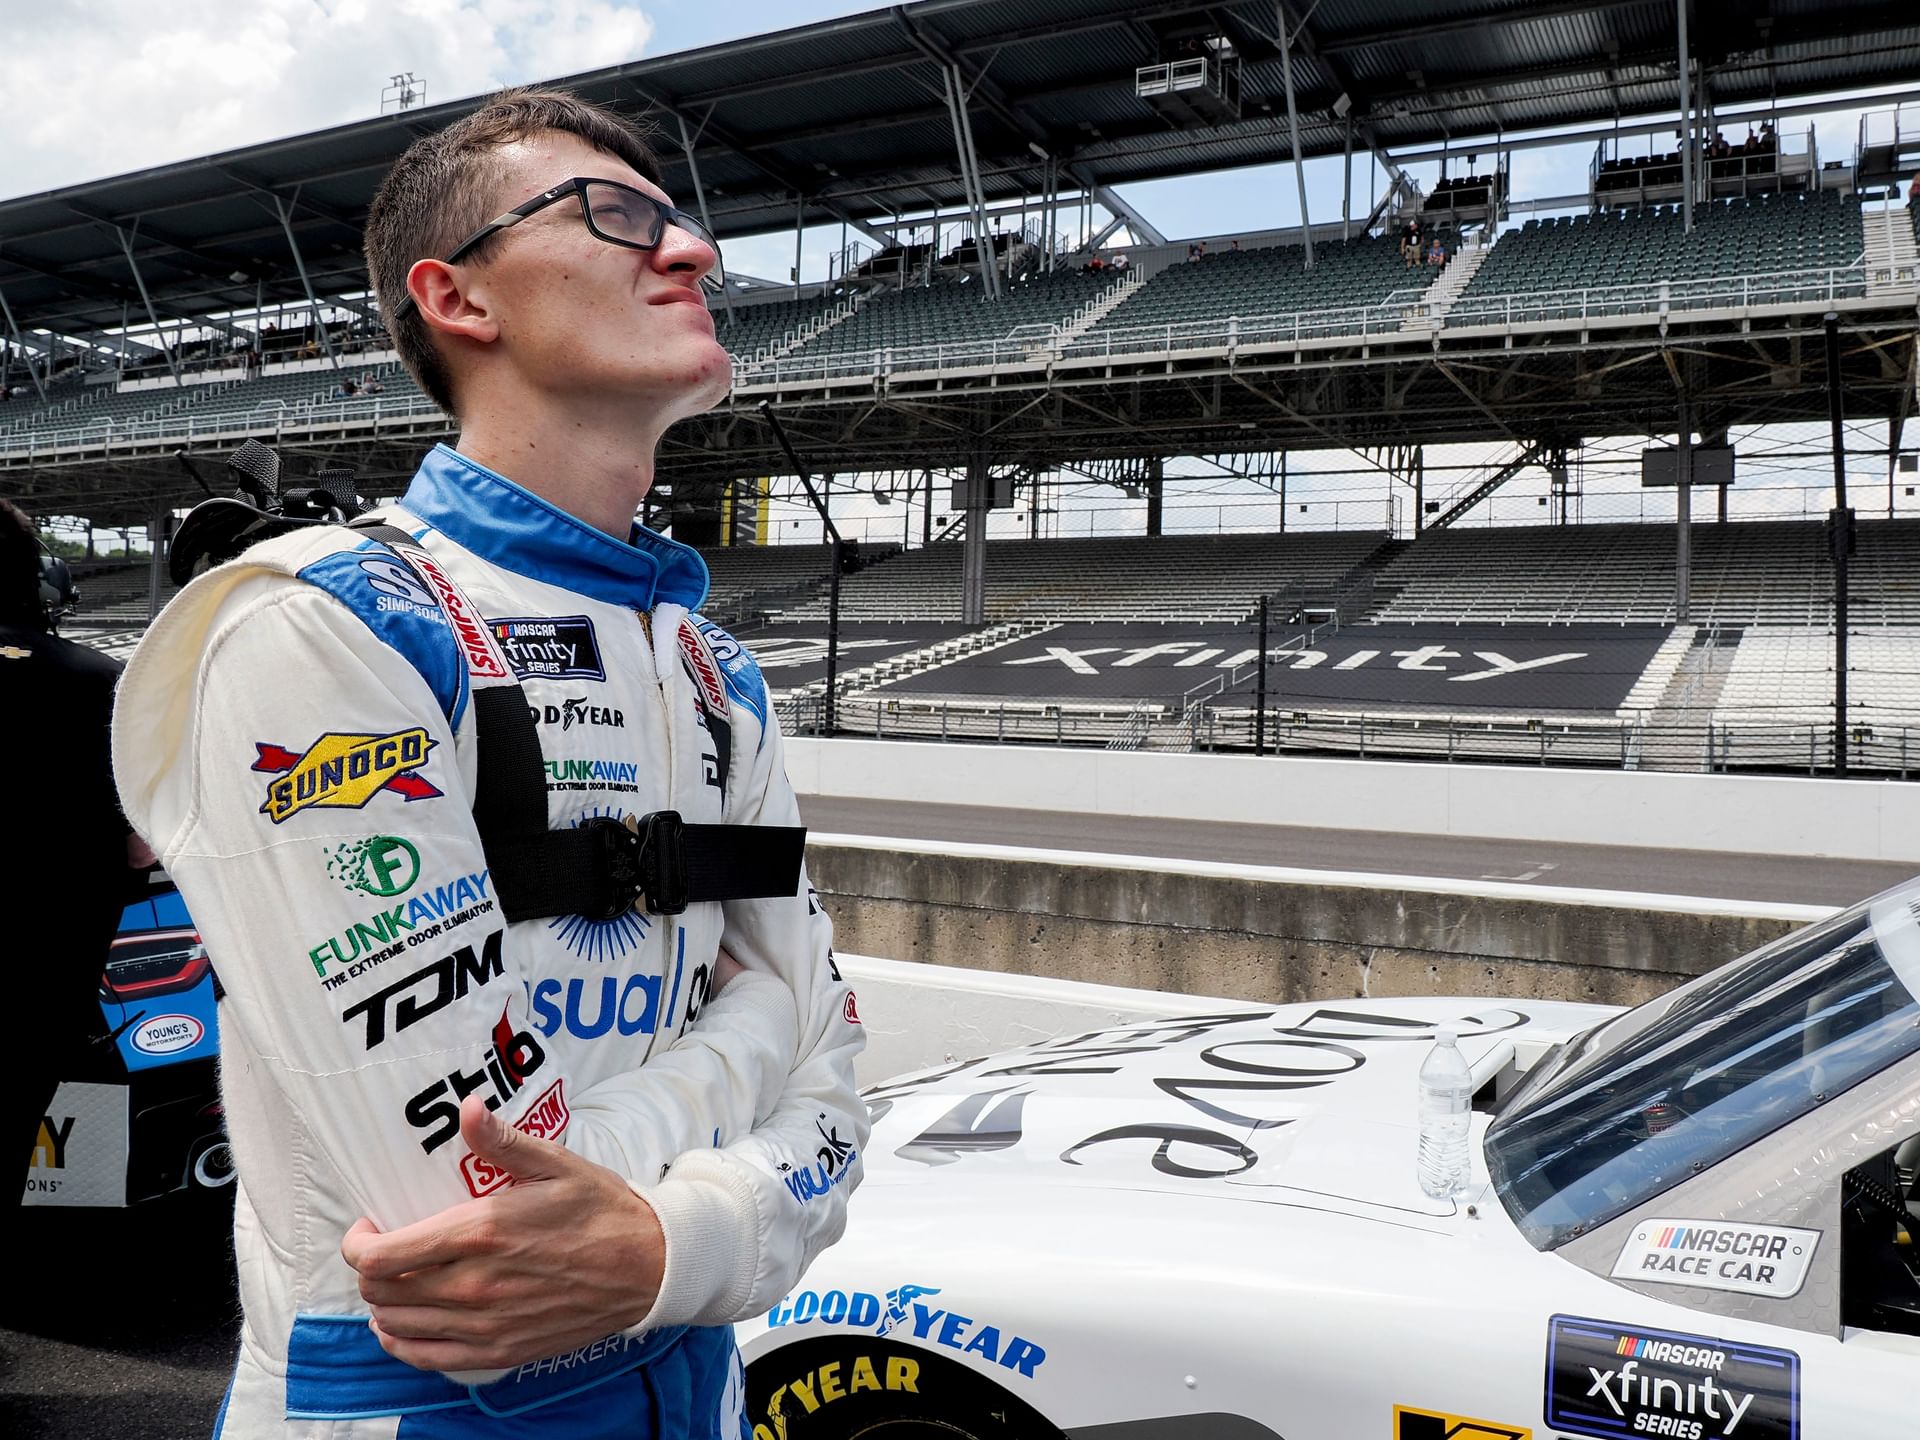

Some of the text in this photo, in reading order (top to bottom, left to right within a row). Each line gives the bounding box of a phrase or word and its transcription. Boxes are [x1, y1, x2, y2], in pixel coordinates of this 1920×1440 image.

[377, 597, 440, 621] SIMPSON
[417, 558, 500, 673] SIMPSON
[514, 624, 556, 637] NASCAR
[527, 662, 561, 673] SERIES
[1002, 642, 1588, 681] xfinity
[275, 735, 421, 814] SUNOCO
[588, 782, 606, 791] ODOR
[308, 869, 490, 978] FUNKAWAY
[321, 900, 494, 992] THE EXTREME ODOR ELIMINATOR
[146, 1023, 188, 1040] YOUNG'S
[146, 1033, 193, 1047] MOTORSPORTS
[1680, 1227, 1788, 1260] NASCAR
[1641, 1253, 1775, 1284] RACE CAR
[516, 1333, 622, 1383] PARKER
[1641, 1339, 1726, 1372] NASCAR
[1586, 1361, 1754, 1436] xfinity
[1633, 1412, 1704, 1440] SERIES
